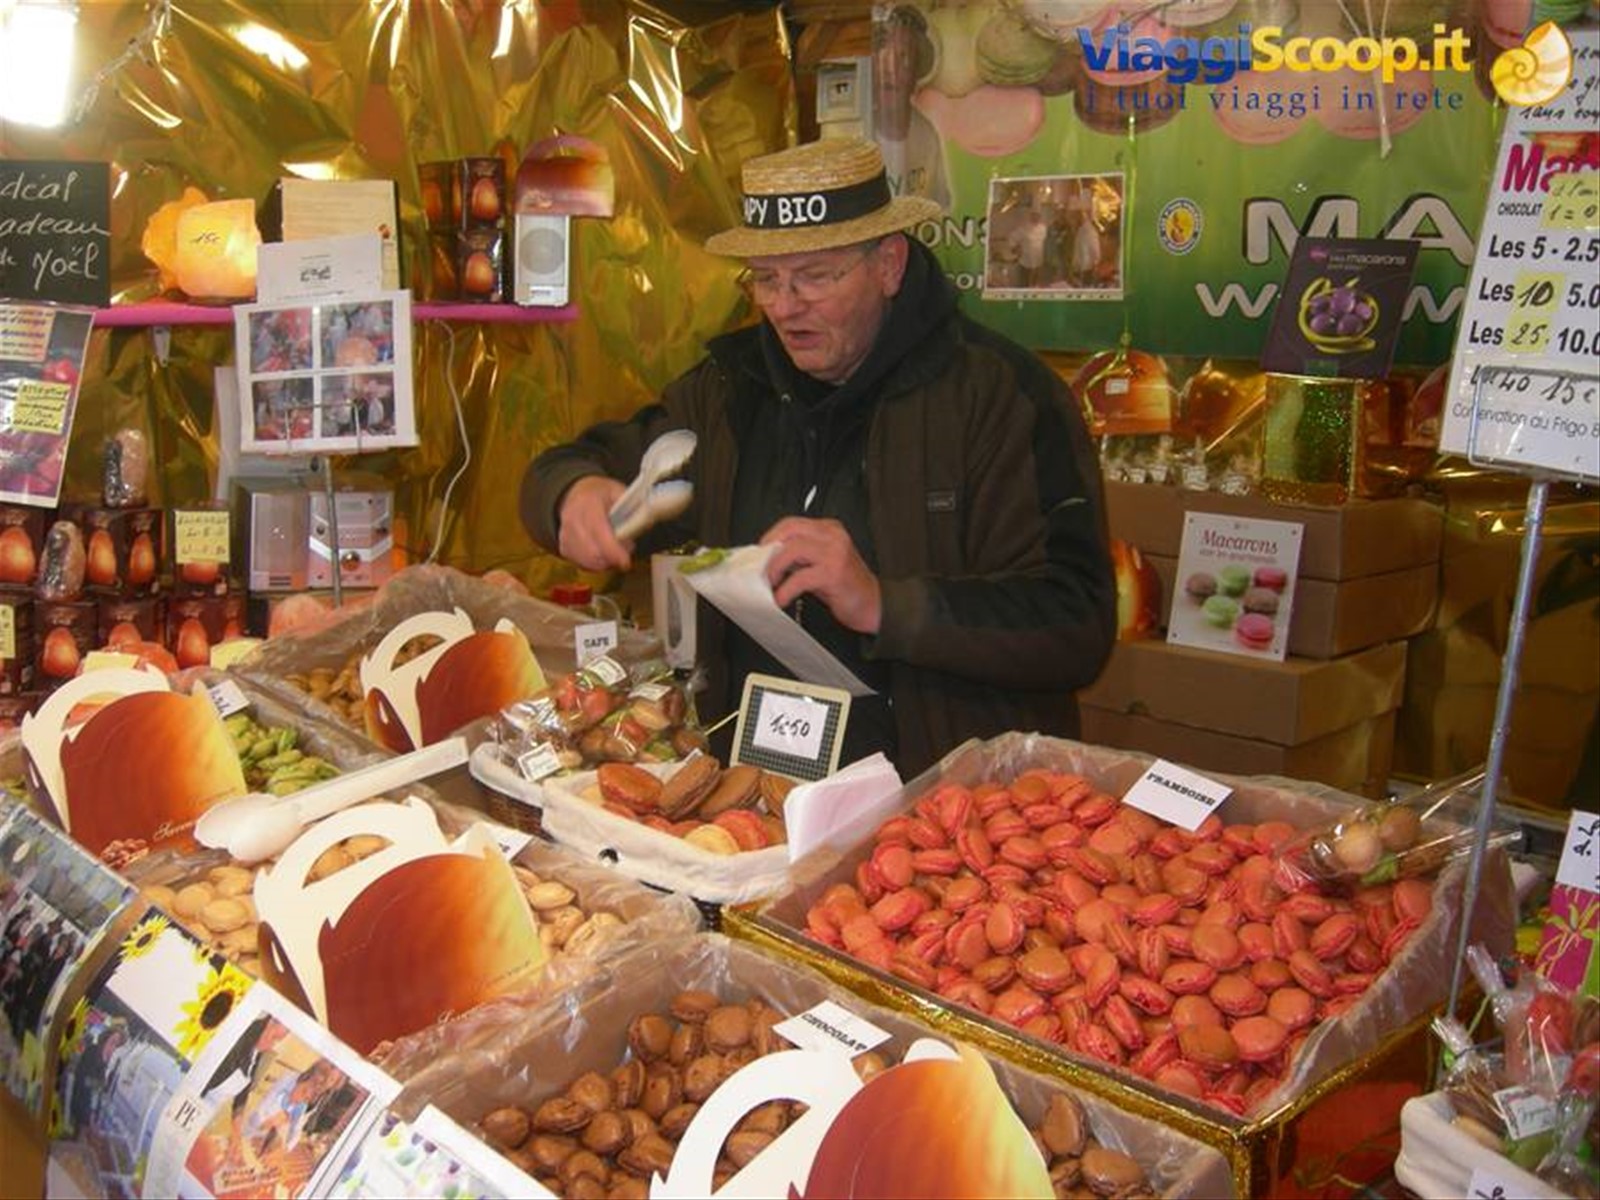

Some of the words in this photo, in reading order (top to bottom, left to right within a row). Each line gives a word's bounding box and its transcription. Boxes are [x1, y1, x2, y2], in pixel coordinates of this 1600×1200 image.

[778, 195, 827, 226] BIO
[1489, 235, 1525, 259] Les
[1531, 237, 1547, 260] 5
[1479, 278, 1514, 302] Les
[1469, 320, 1504, 345] Les
[1530, 413, 1550, 430] au
[1553, 417, 1588, 439] Frigo
[1202, 528, 1279, 555] Macarons
[1146, 772, 1217, 807] FRAMBOISE
[800, 1012, 868, 1052] CHOCOLAT
